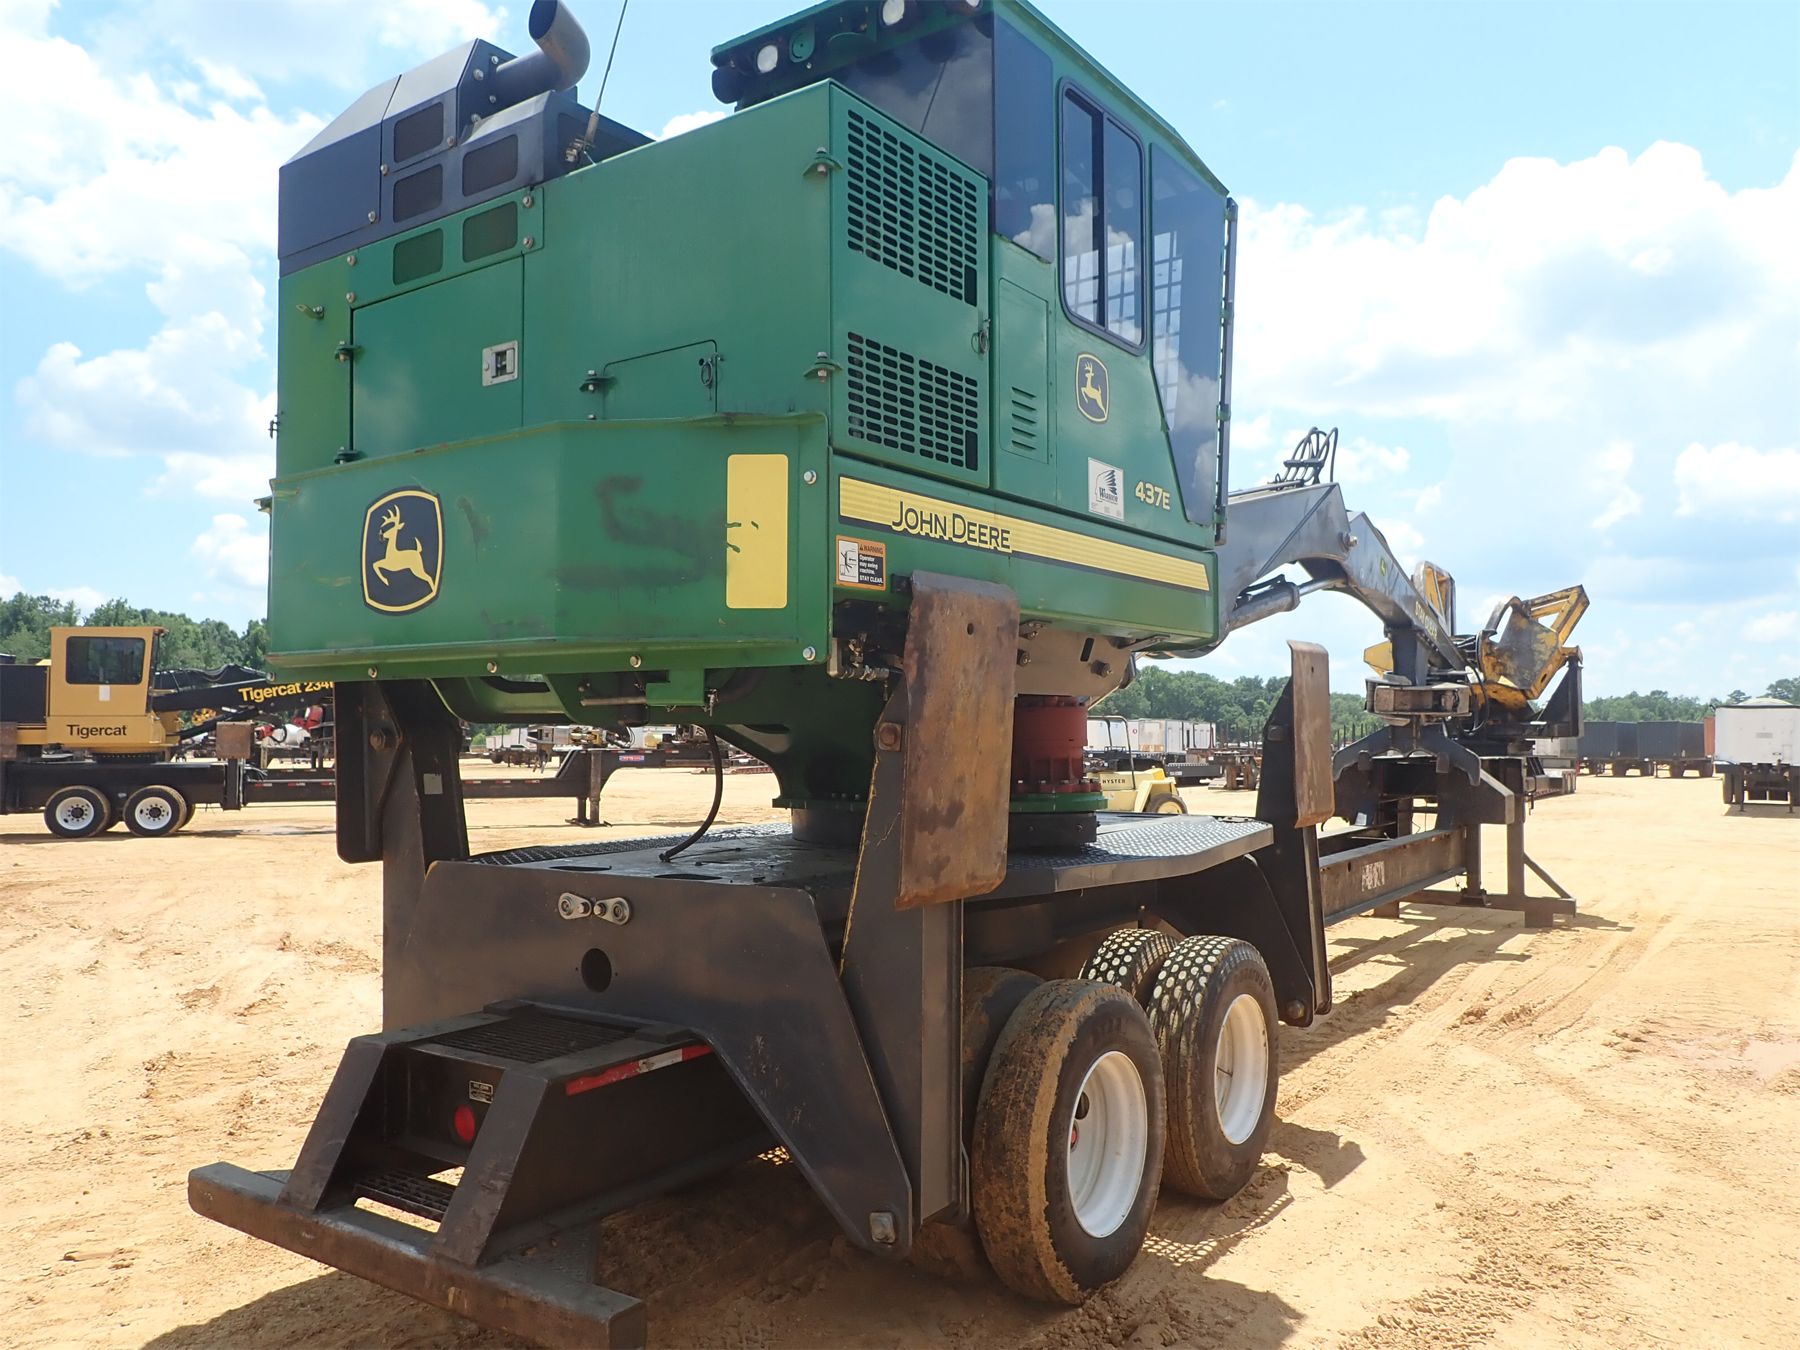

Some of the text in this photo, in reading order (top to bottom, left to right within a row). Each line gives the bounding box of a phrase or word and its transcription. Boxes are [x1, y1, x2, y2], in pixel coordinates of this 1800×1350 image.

[1135, 480, 1171, 510] 437E
[892, 501, 1012, 551] JOHN DEERE
[238, 682, 302, 702] Tigercat
[66, 724, 127, 739] Tigercat
